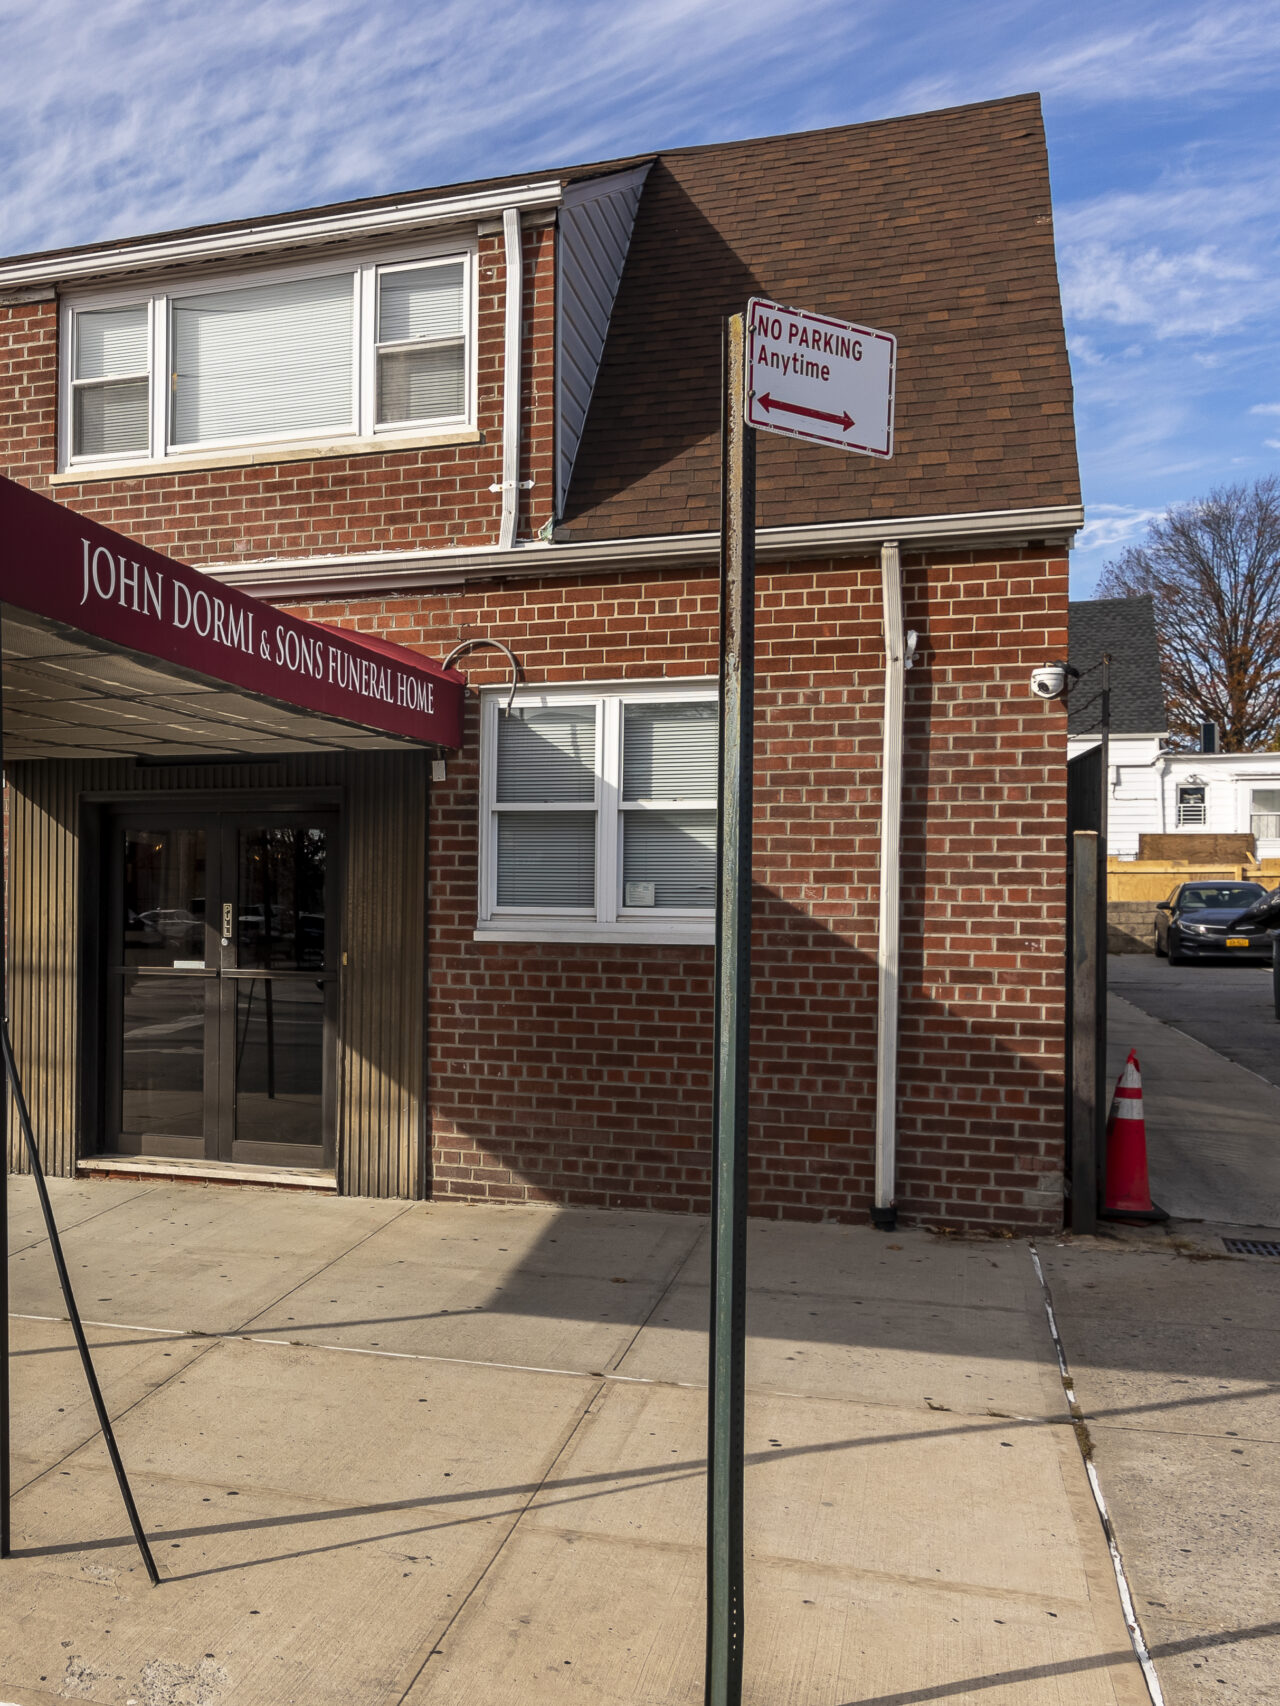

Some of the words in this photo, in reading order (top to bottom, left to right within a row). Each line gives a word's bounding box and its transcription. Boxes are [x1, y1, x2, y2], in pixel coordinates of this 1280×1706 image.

[757, 314, 782, 341] NO
[788, 322, 863, 362] PARKING
[757, 344, 830, 381] Anytime
[80, 537, 163, 621] JOHN
[172, 579, 255, 655] DORMI
[259, 629, 272, 662] &
[275, 624, 324, 680] SONS
[328, 645, 394, 704] FUNERAL
[396, 672, 434, 714] HOME
